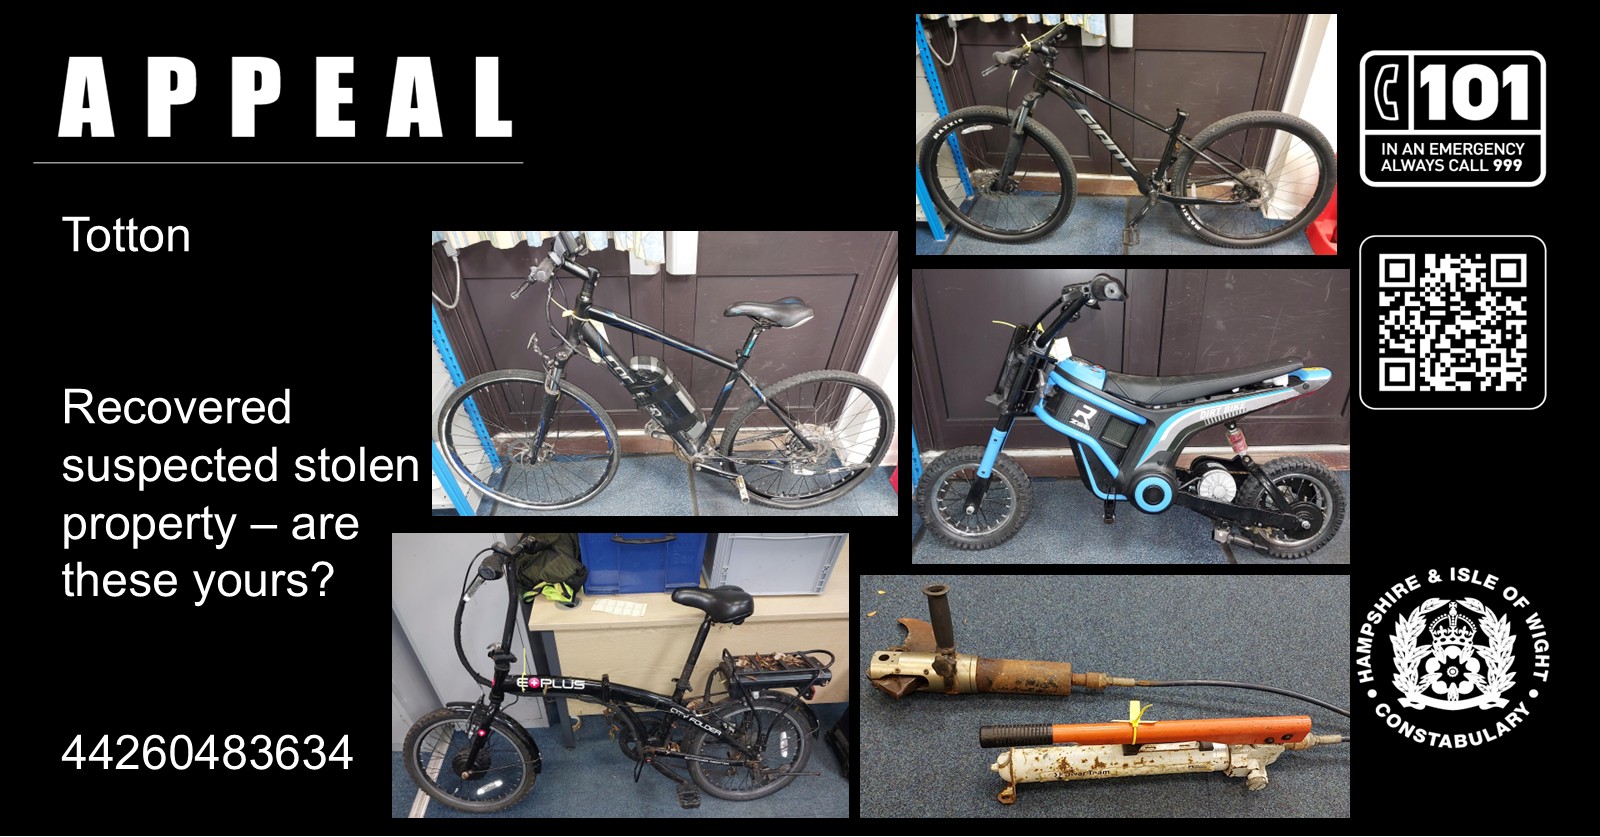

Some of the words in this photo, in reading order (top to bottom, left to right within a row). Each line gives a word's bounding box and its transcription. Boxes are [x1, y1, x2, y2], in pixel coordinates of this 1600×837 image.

[1200, 406, 1222, 419] DIRT
[1223, 402, 1246, 415] BIKE
[689, 717, 722, 736] FOLDER
